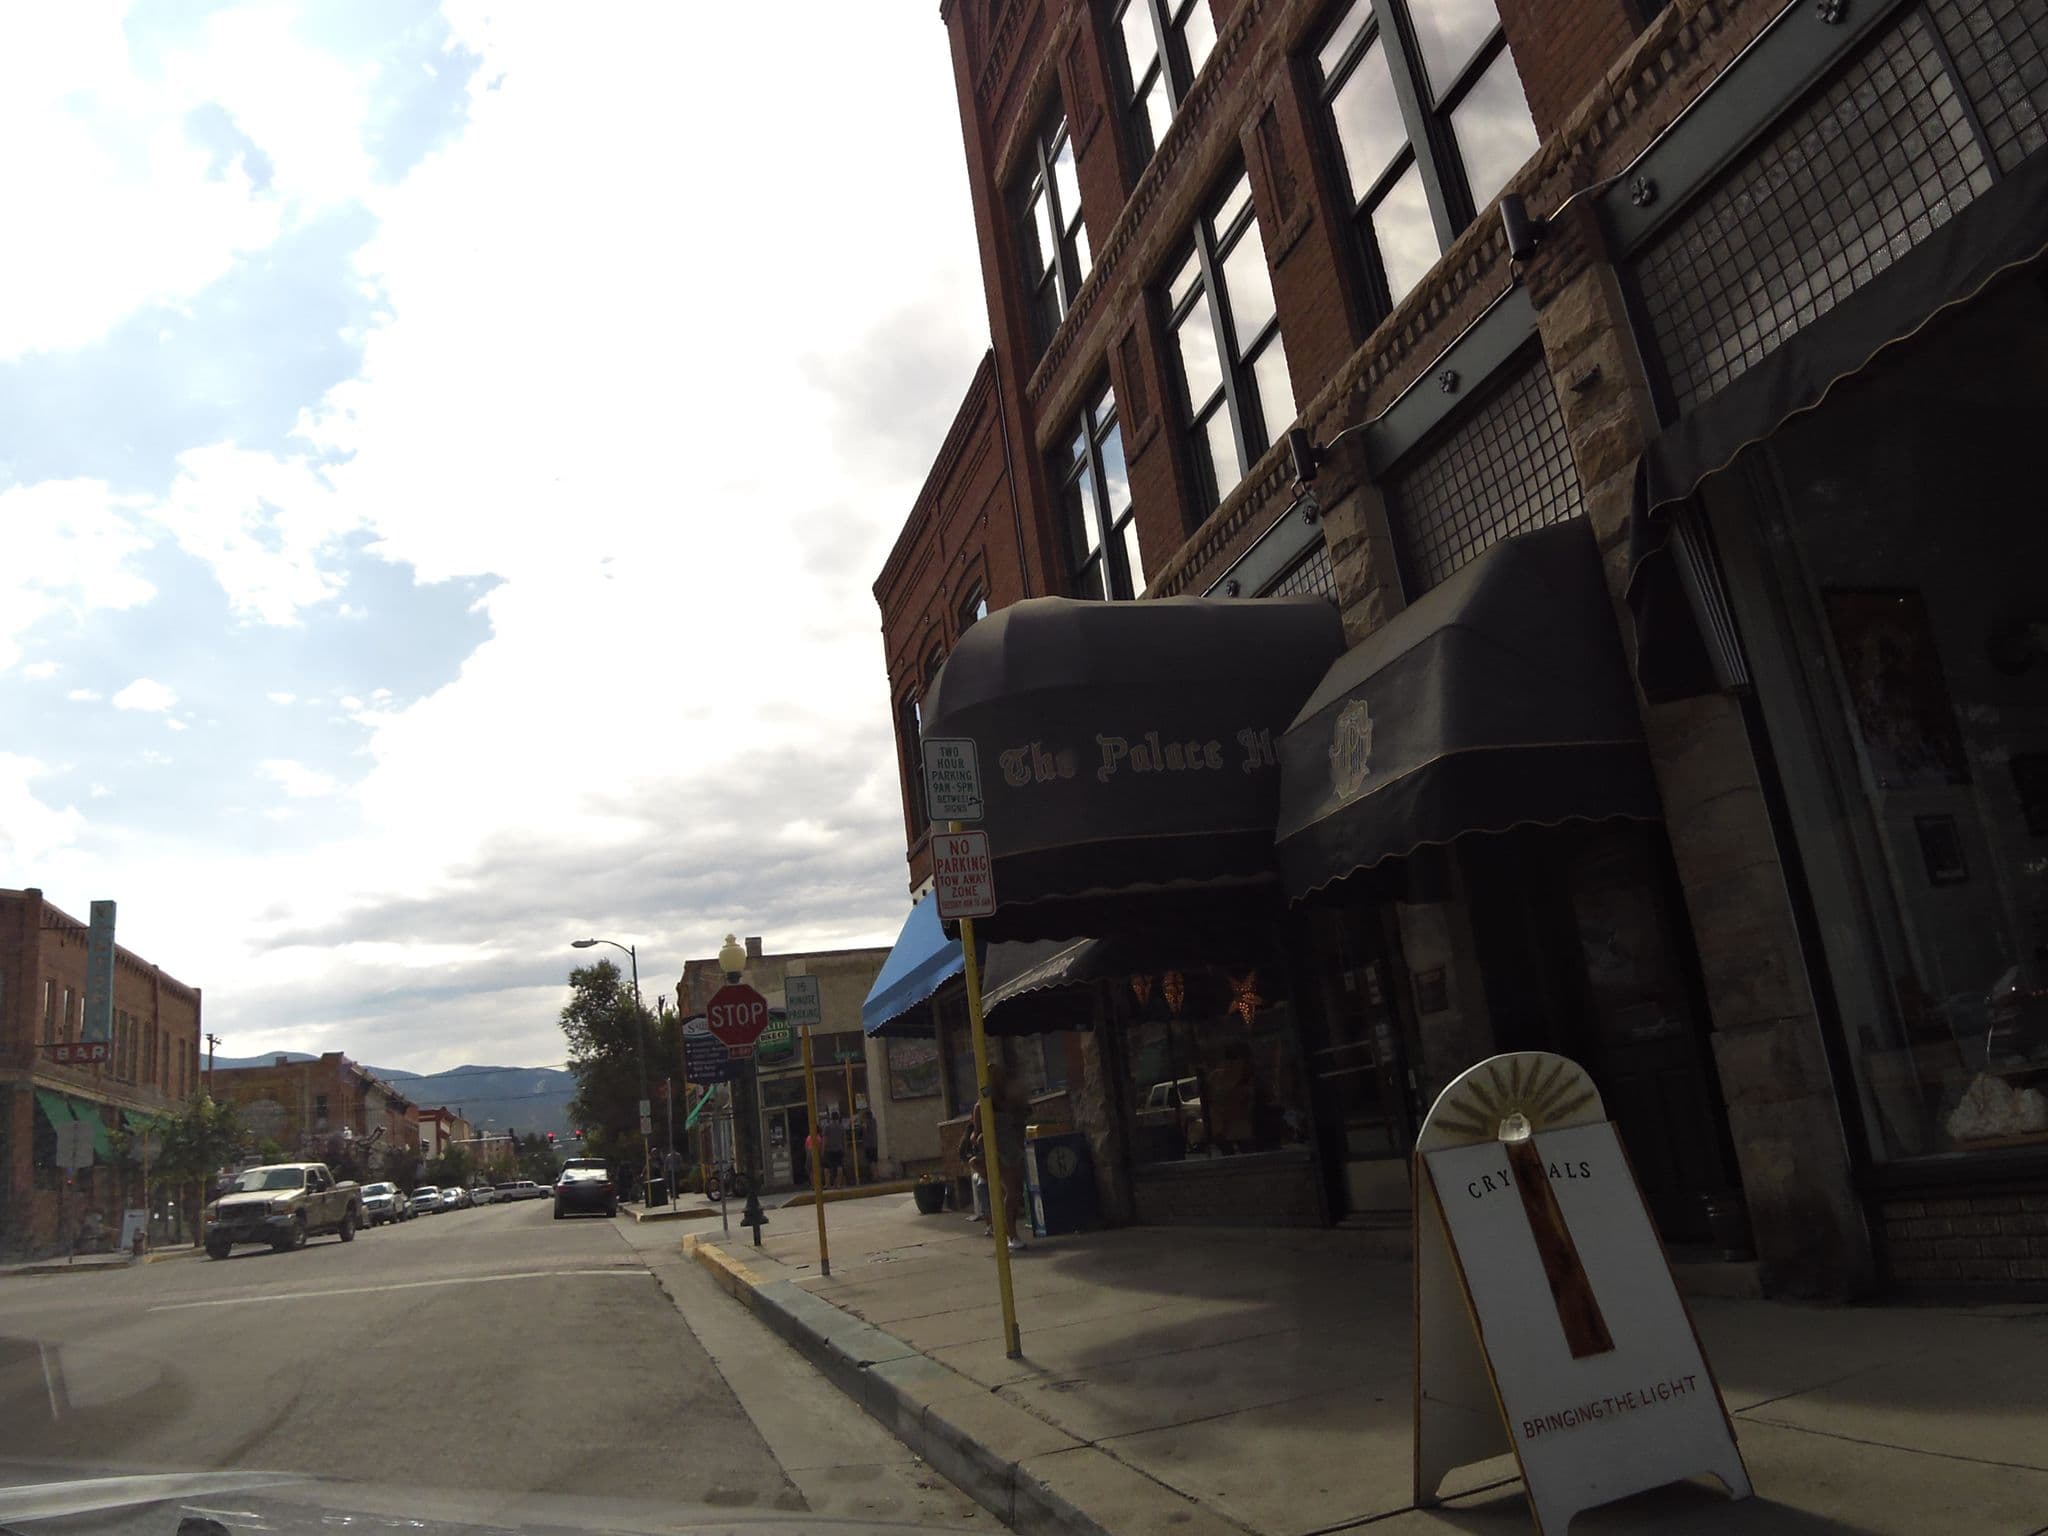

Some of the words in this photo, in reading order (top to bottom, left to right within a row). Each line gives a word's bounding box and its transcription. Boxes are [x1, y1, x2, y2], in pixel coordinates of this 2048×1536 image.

[940, 746, 959, 757] TWO
[999, 739, 1079, 786] The
[1096, 730, 1225, 783] Palace
[937, 758, 965, 769] HOUR
[931, 770, 972, 781] PARKING
[949, 839, 969, 855] NO
[937, 855, 987, 874] PARKING
[939, 875, 959, 887] TOW
[963, 872, 988, 885] AWAY
[951, 885, 979, 898] ZONE
[711, 1002, 763, 1028] STOP
[56, 1046, 105, 1061] BAR
[1641, 1375, 1697, 1405] LIGHT
